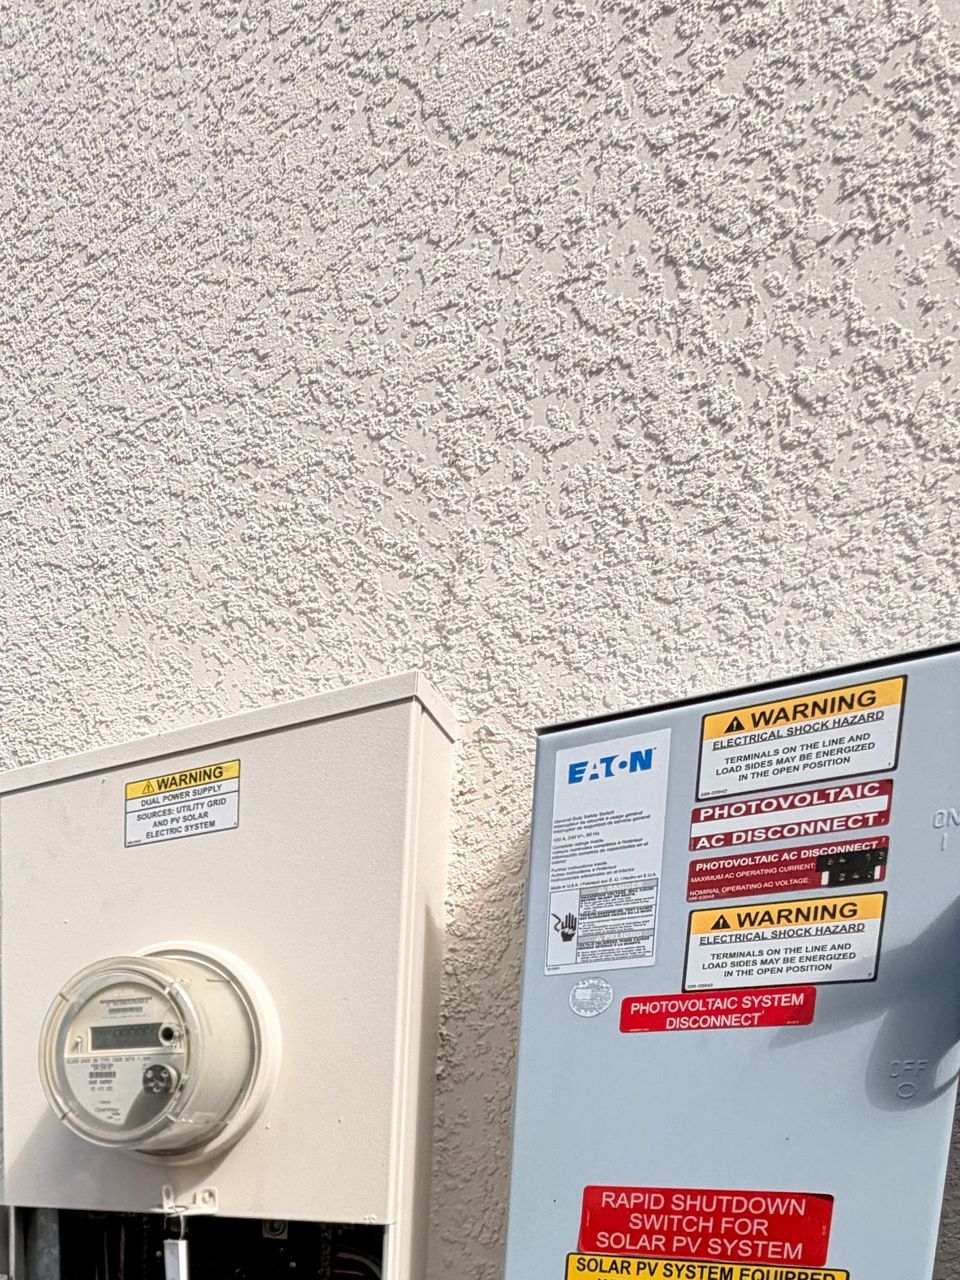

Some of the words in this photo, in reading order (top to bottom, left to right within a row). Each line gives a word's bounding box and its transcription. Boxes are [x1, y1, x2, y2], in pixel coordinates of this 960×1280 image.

[751, 690, 876, 728] WARNING
[713, 730, 783, 750] ELECTRICAL
[787, 722, 828, 737] SHOCK
[833, 711, 884, 728] HAZARD
[716, 765, 742, 775] LOAD
[745, 759, 773, 771] SIDES
[776, 756, 797, 765] MAY
[799, 753, 812, 761] BE
[816, 743, 875, 759] ENERGIZED
[725, 749, 779, 765] TERMINALS
[782, 746, 796, 754] ON
[800, 742, 819, 751] THE
[823, 737, 845, 748] LINE
[847, 733, 870, 743] AND
[157, 766, 224, 790] WARNING
[568, 749, 653, 784] EATON
[739, 773, 748, 781] IN
[751, 769, 769, 779] THE
[773, 764, 799, 775] OPEN
[802, 757, 851, 771] POSITION
[141, 798, 160, 806] DUAL
[163, 792, 190, 802] POWER
[192, 784, 222, 796] SUPPLY
[700, 783, 879, 821] PHOTOVOLTAIC
[136, 809, 174, 821] SOURCES:
[176, 802, 204, 814] UTILITY
[207, 798, 226, 808] GRID
[153, 820, 168, 828] AND
[182, 812, 208, 822] SOLAR
[146, 826, 182, 838] ELECTRIC
[184, 821, 215, 832] SYSTEM
[696, 837, 724, 849] AC
[732, 813, 878, 844] DISCONNECT
[696, 853, 778, 871] PHOTOVOLTAIC
[781, 851, 798, 860] AC
[801, 841, 878, 859] DISCONNECT
[691, 873, 724, 883] MAXIMUM
[725, 871, 734, 879] AC
[736, 867, 777, 877] OPERATING
[689, 888, 719, 896] NOMINAL
[721, 883, 762, 893] OPERATING
[737, 902, 857, 928] WARNING
[699, 931, 767, 946] ELECTRICAL
[771, 928, 812, 939] SHOCK
[816, 923, 865, 936] HAZARD
[702, 960, 727, 970] LOAD
[730, 958, 757, 968] SIDES
[760, 957, 780, 965] MAY
[783, 956, 796, 964] BE
[798, 952, 856, 962] ENERGIZED
[711, 949, 764, 960] TERMINALS
[767, 947, 781, 955] ON
[783, 946, 803, 954] THE
[805, 944, 827, 952] LINE
[830, 943, 851, 951] AND
[736, 968, 754, 977] THE
[756, 966, 783, 975] OPEN
[786, 963, 831, 973] POSITION
[631, 997, 737, 1015] PHOTOVOLTAIC
[741, 994, 803, 1008] SYSTEM
[666, 1013, 760, 1029] DISCONNECT
[890, 1061, 928, 1078] OFF
[601, 1192, 665, 1210] RAPID
[671, 1194, 806, 1216] SHUTDOWN
[629, 1214, 713, 1233] SWITCH
[721, 1218, 768, 1236] FOR
[596, 1232, 666, 1252] SOLAR
[673, 1237, 702, 1253] PV
[708, 1239, 803, 1260] SYSTEM
[576, 1258, 631, 1274] SOLAR
[636, 1261, 657, 1275] PV
